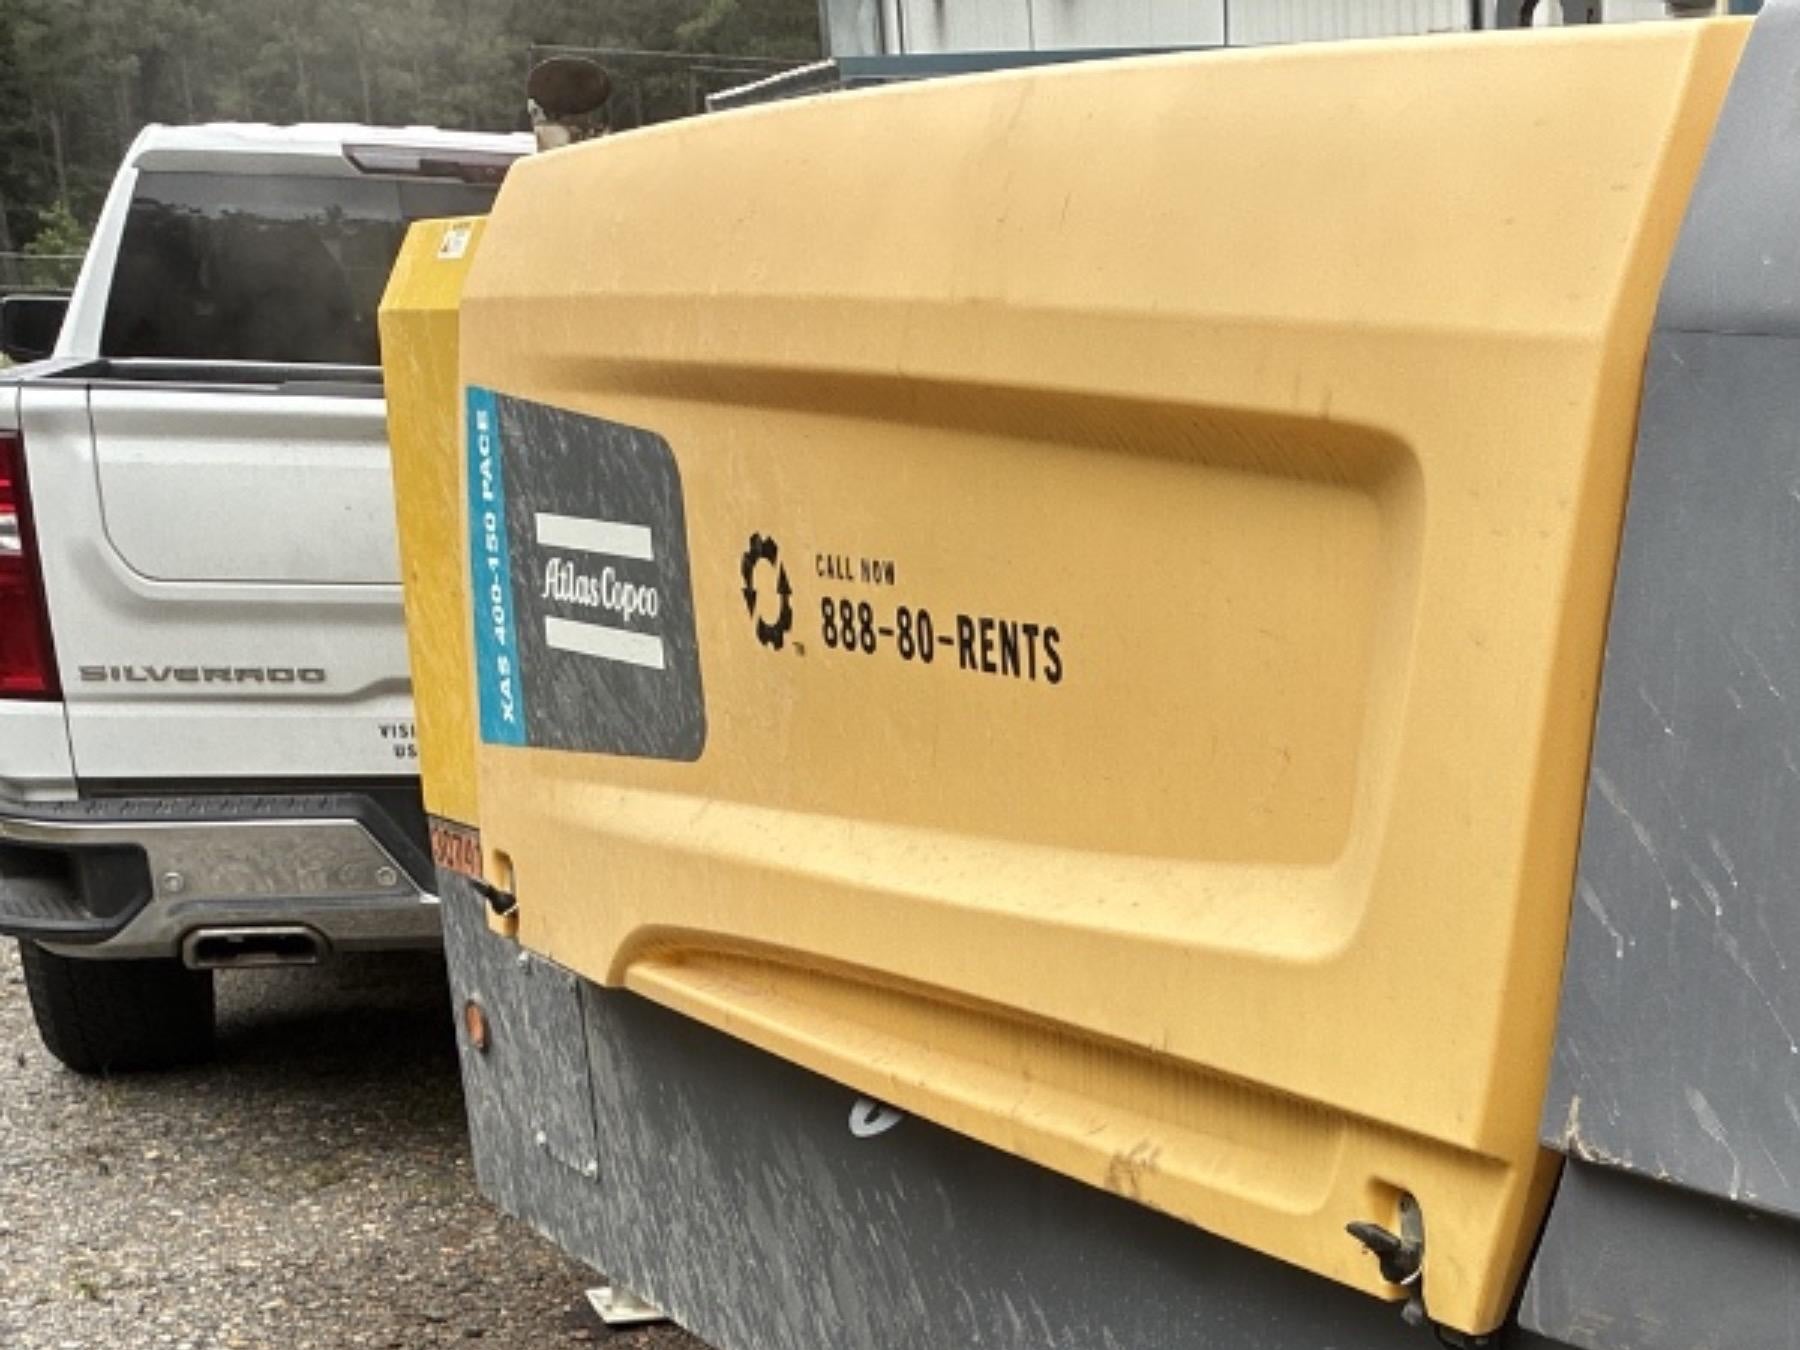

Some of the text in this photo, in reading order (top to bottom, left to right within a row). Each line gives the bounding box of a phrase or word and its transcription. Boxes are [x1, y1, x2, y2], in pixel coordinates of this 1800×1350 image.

[476, 410, 515, 723] XAS 400-150 PACE
[541, 557, 659, 621] Atlas Copco
[815, 553, 896, 586] CALL NOW
[821, 596, 1063, 685] 888-80-RENTS
[78, 664, 326, 684] SILVERADO
